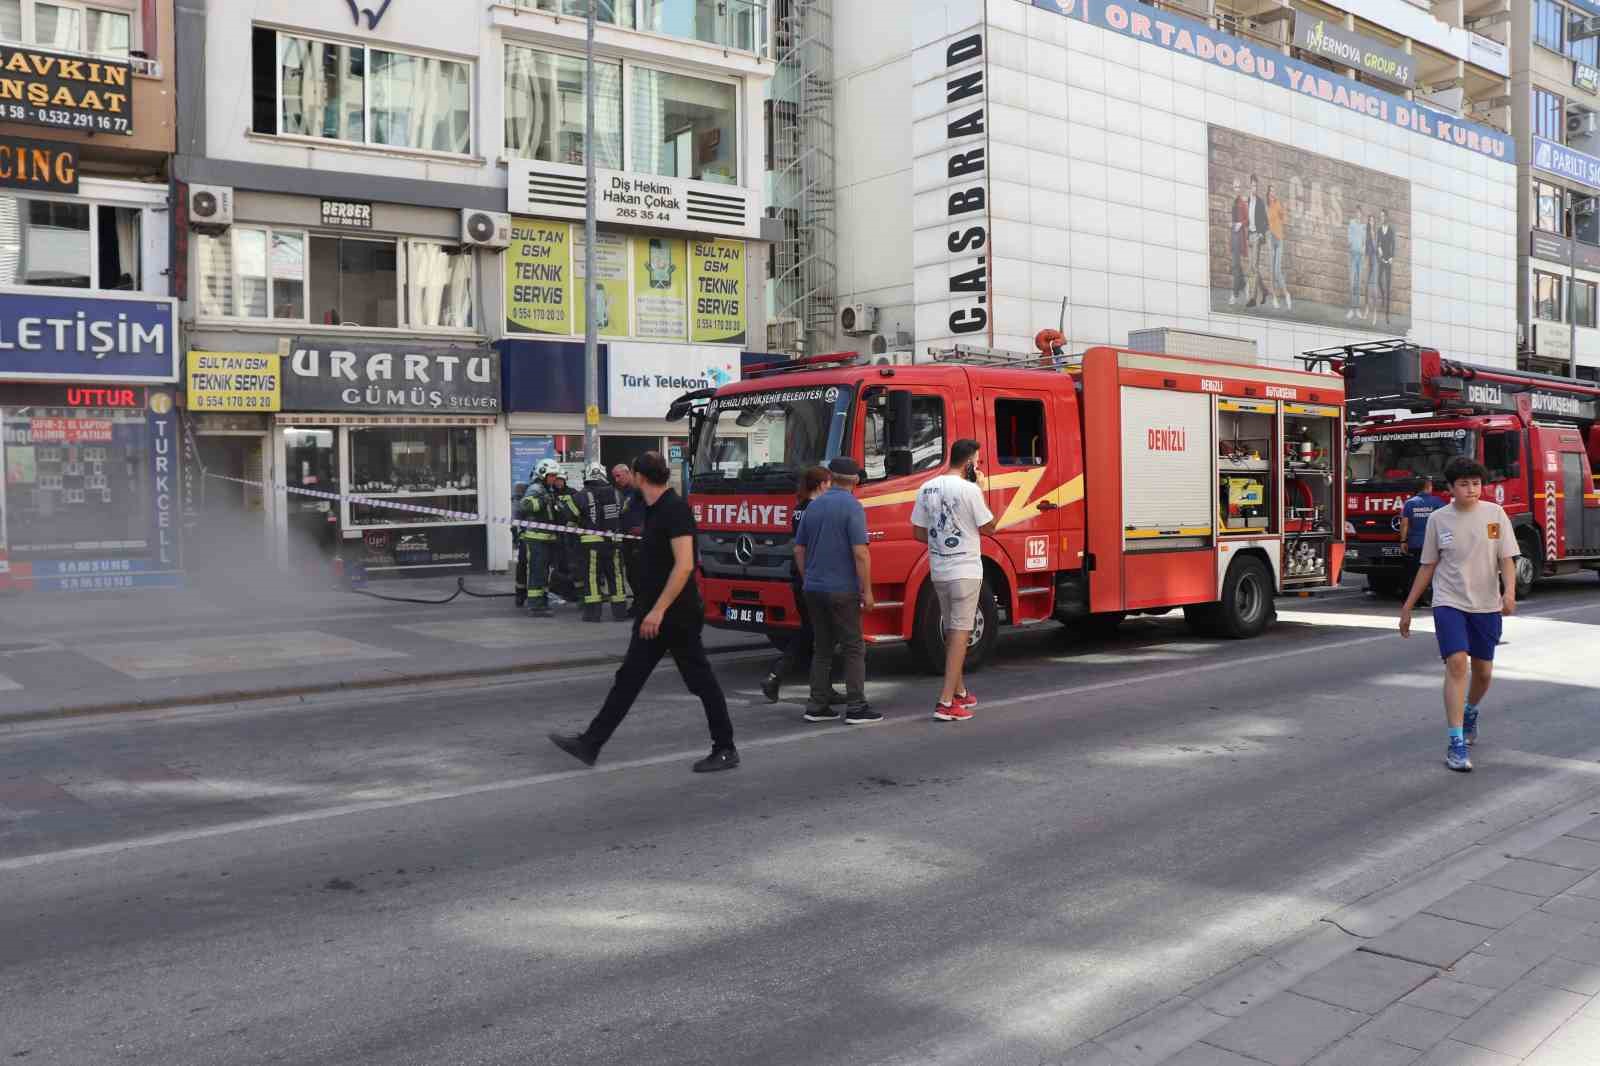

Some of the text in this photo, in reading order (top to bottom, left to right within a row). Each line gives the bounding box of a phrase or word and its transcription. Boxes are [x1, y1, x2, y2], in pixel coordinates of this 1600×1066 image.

[1364, 52, 1396, 75] GROUP
[10, 105, 25, 119] 58
[38, 109, 70, 124] 0.532
[73, 113, 94, 127] 291
[97, 116, 111, 129] 16
[114, 118, 128, 131] 77
[1438, 120, 1505, 157] KURSU
[612, 176, 631, 192] Diş
[603, 189, 680, 209] Hakan Çokak
[323, 201, 370, 219] BERBER
[616, 207, 670, 221] 265 35 44
[511, 227, 564, 243] SULTAN
[521, 244, 551, 258] GSM
[695, 244, 740, 260] SULTAN
[703, 260, 729, 273] GSM
[199, 356, 268, 370] SULTAN GSM
[291, 349, 491, 384] URARTU
[621, 374, 709, 389] Türk Telekom
[67, 388, 136, 406] UTTUR
[207, 395, 223, 407] 554
[342, 385, 497, 408] GÜMÜŞ SILVER
[1148, 423, 1185, 451] DENİZLİ
[155, 420, 171, 563] TURKCELL
[1029, 540, 1046, 555] 112
[58, 560, 130, 572] SAMSUNG
